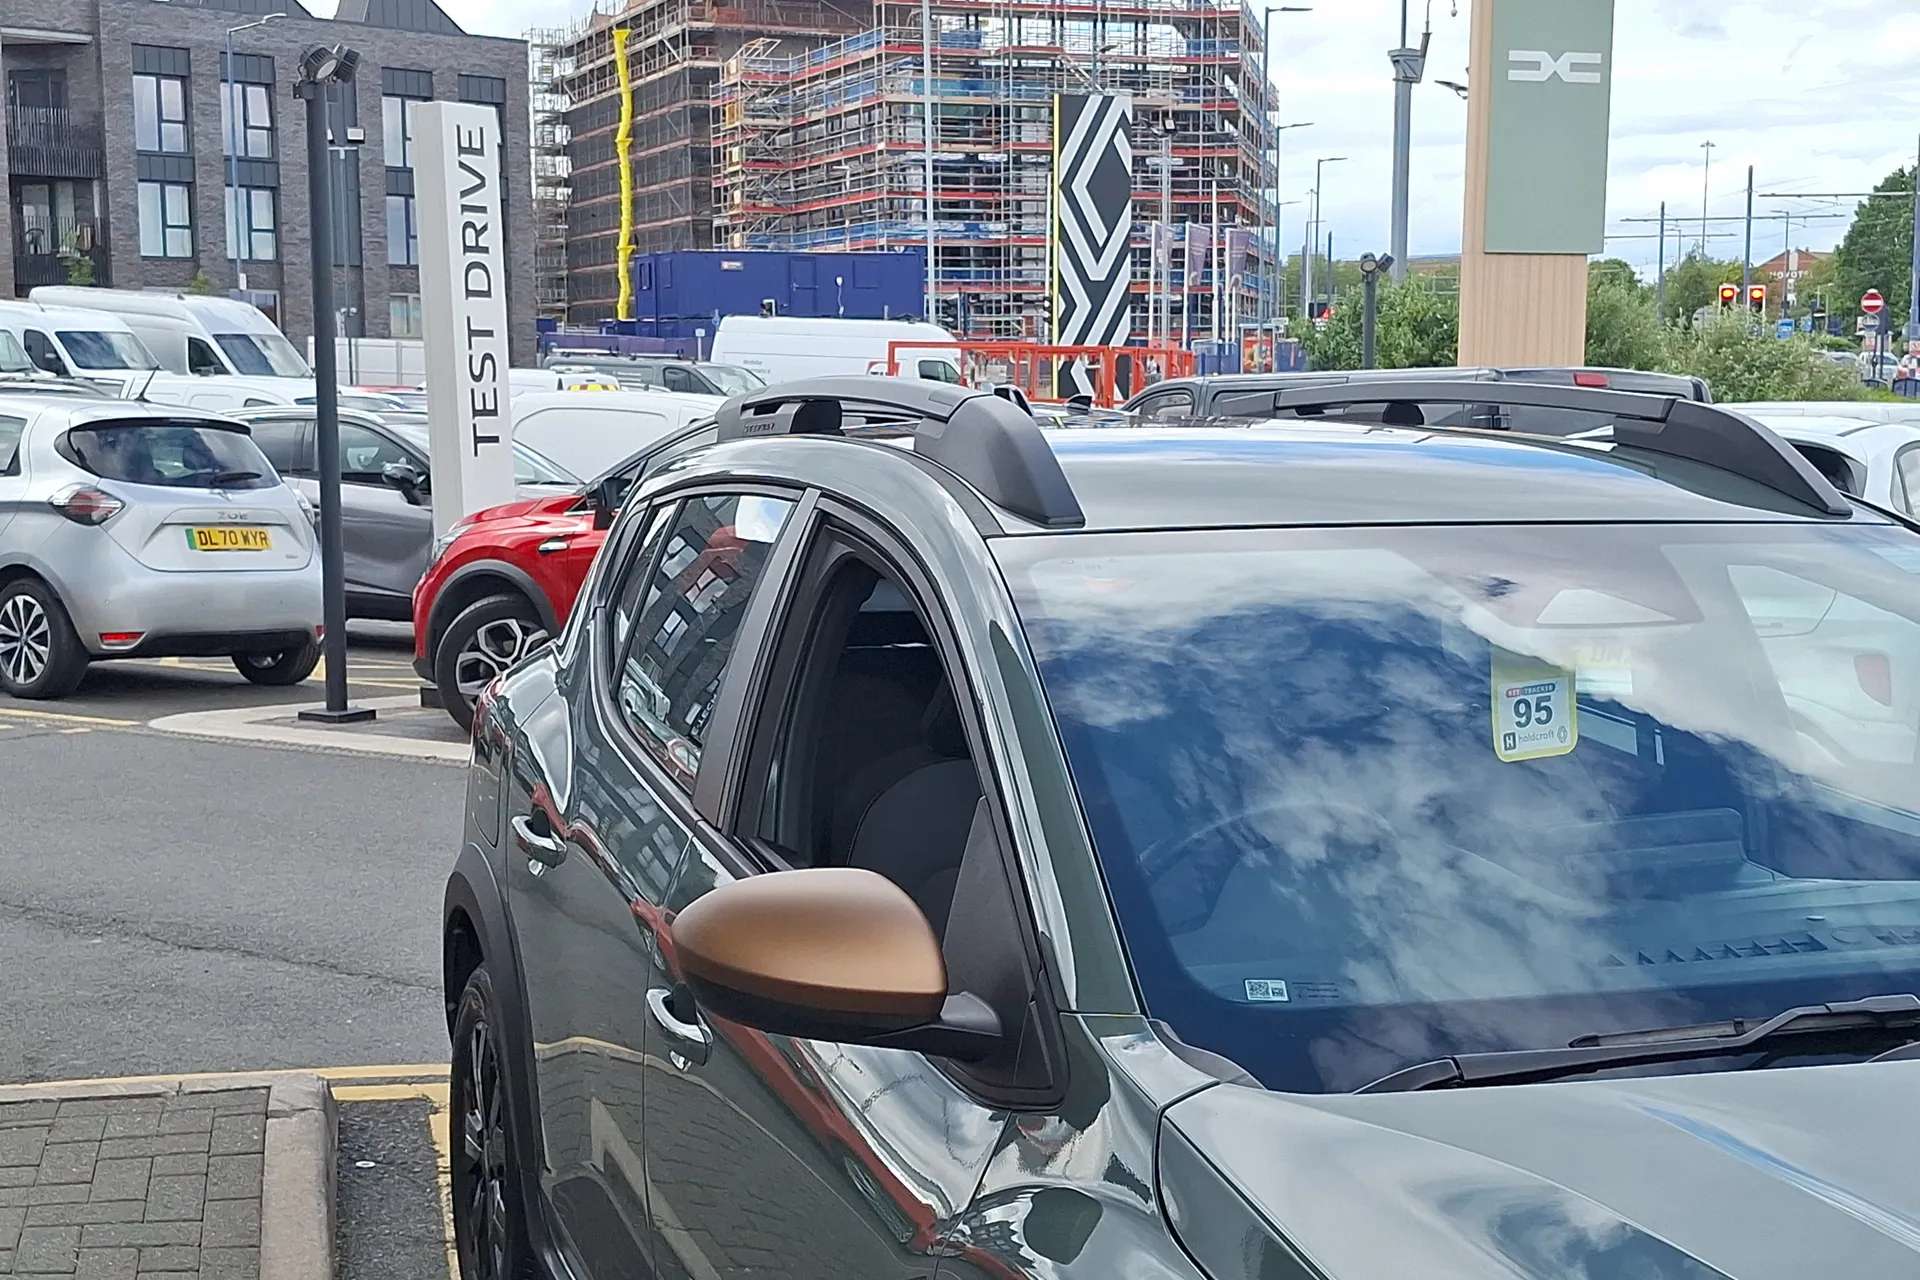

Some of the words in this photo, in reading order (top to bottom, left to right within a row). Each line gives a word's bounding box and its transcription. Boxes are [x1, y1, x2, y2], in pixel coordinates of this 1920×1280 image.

[456, 124, 493, 301] DRIVE
[467, 315, 500, 457] TEST
[197, 529, 238, 547] DL70
[1513, 695, 1553, 729] 95
